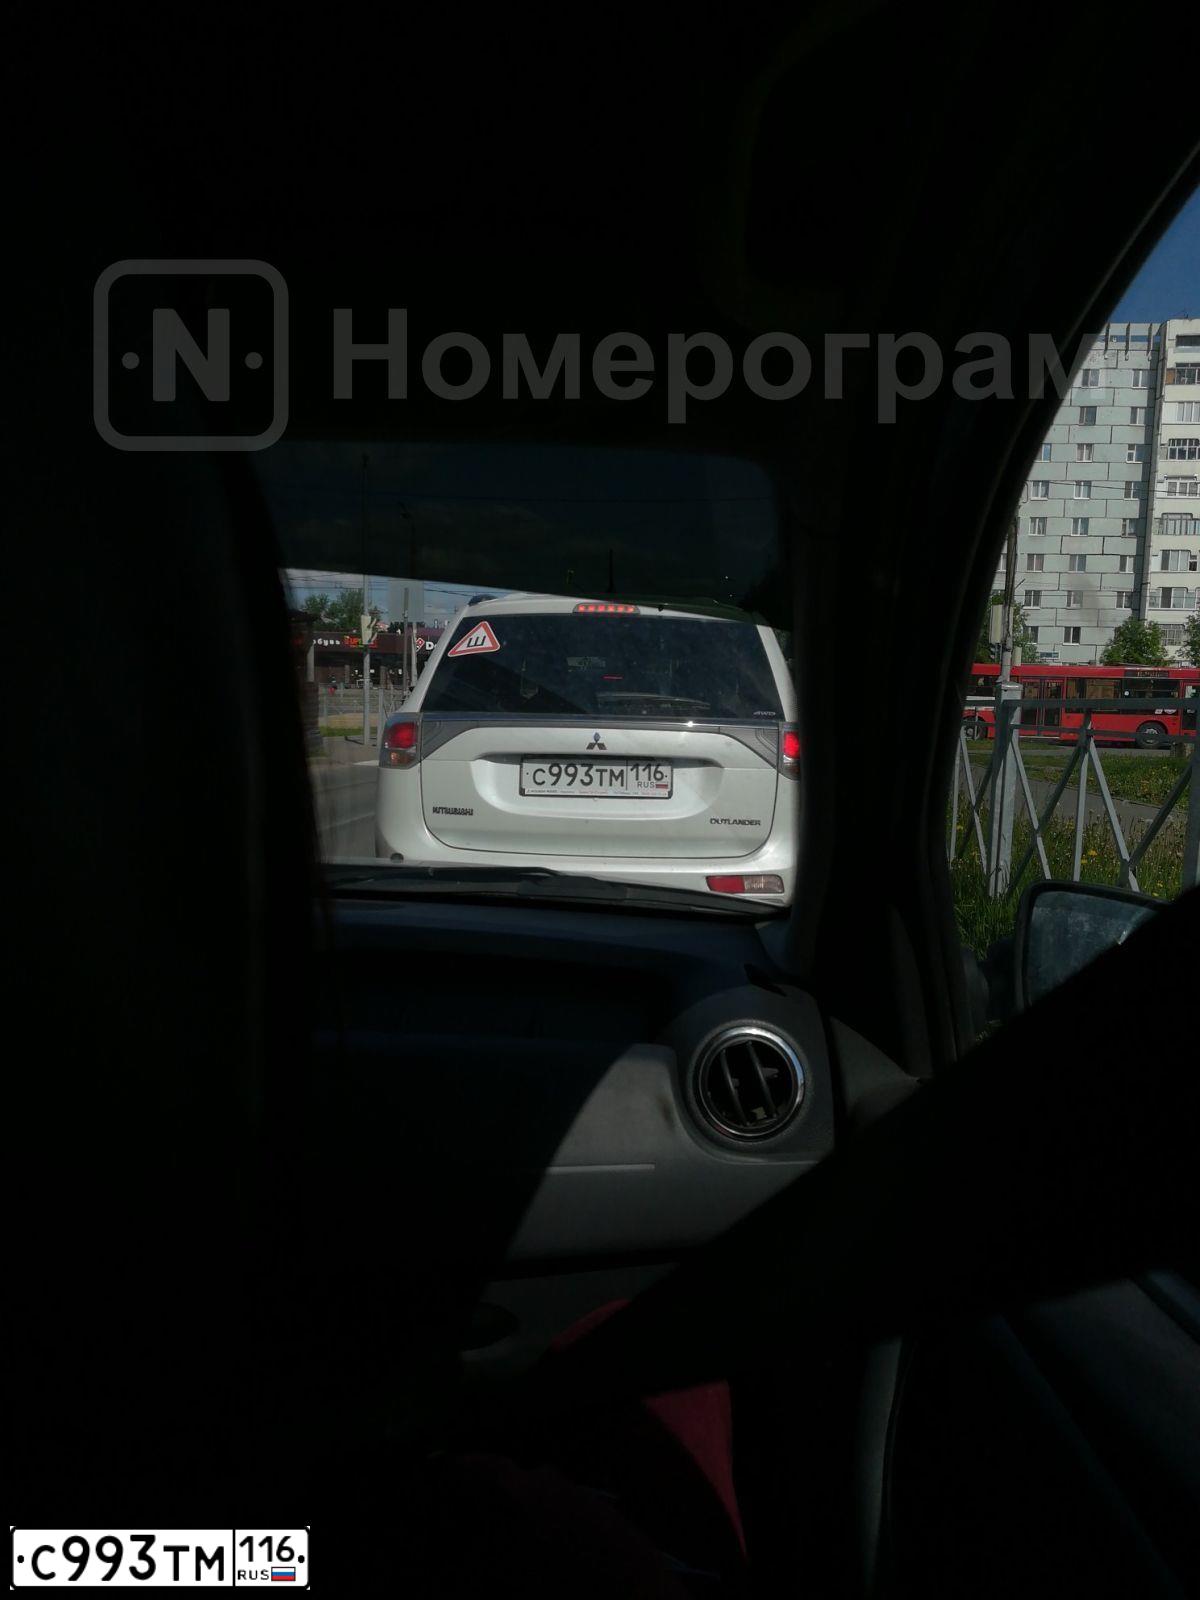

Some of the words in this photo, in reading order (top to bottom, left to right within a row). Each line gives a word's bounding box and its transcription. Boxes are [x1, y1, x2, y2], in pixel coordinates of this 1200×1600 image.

[426, 641, 437, 650] D
[467, 636, 487, 648] Ш
[532, 763, 624, 787] С993ТМ
[630, 763, 664, 781] 116
[637, 781, 655, 789] RUS
[709, 818, 761, 826] OUTLANDER
